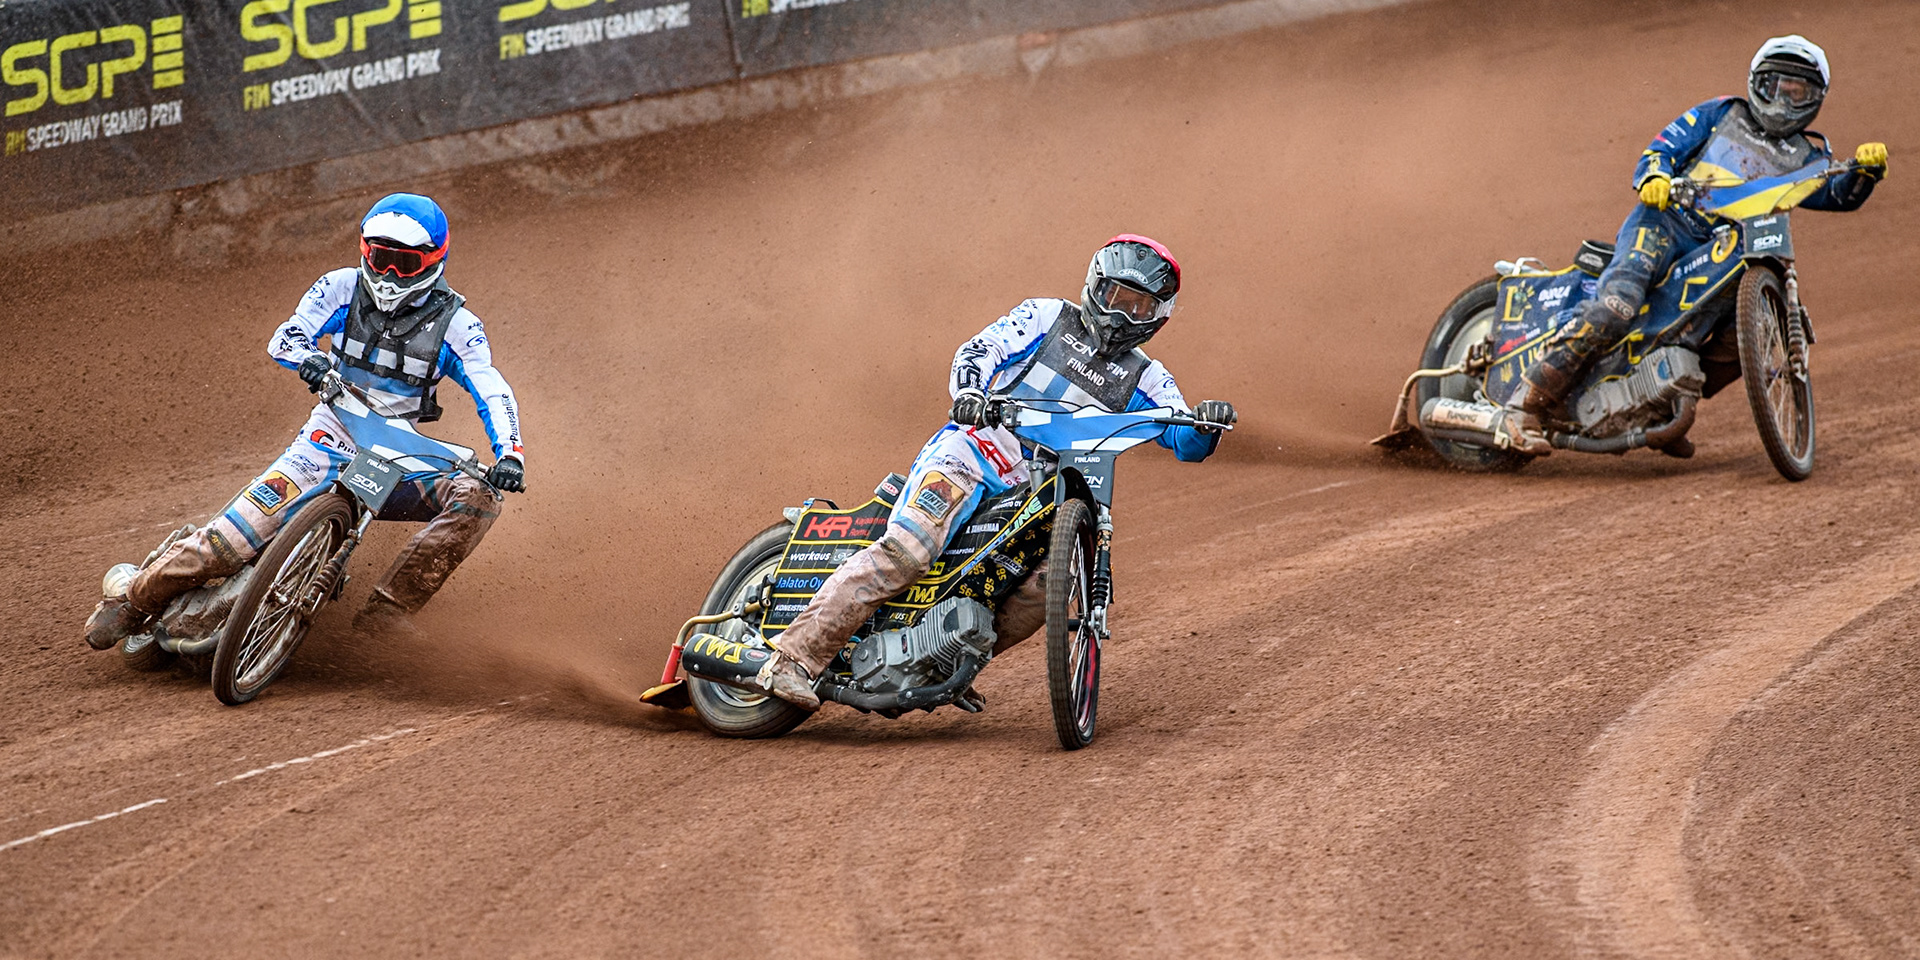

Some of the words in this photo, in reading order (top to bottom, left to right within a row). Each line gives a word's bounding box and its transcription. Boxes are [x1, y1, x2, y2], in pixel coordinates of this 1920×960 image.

[526, 17, 603, 55] SPEEDWAY
[244, 83, 271, 111] FIM
[271, 67, 350, 105] SPEEDWAY
[352, 56, 404, 90] GRAND
[407, 49, 441, 78] PRIX
[27, 115, 100, 151] SPEEDWAY
[102, 106, 147, 137] GRAND
[150, 100, 183, 129] PRIX
[1753, 234, 1783, 247] SON
[1060, 332, 1098, 357] SON
[1066, 357, 1105, 386] FINLAND
[1107, 361, 1130, 380] FIM
[366, 458, 390, 474] FINLAND
[1074, 456, 1101, 464] FINLAND
[350, 473, 384, 493] SON
[1083, 475, 1105, 486] ON
[803, 516, 853, 538] KR
[790, 550, 832, 561] warkaus
[775, 576, 809, 589] Jalator
[809, 576, 824, 591] Oy
